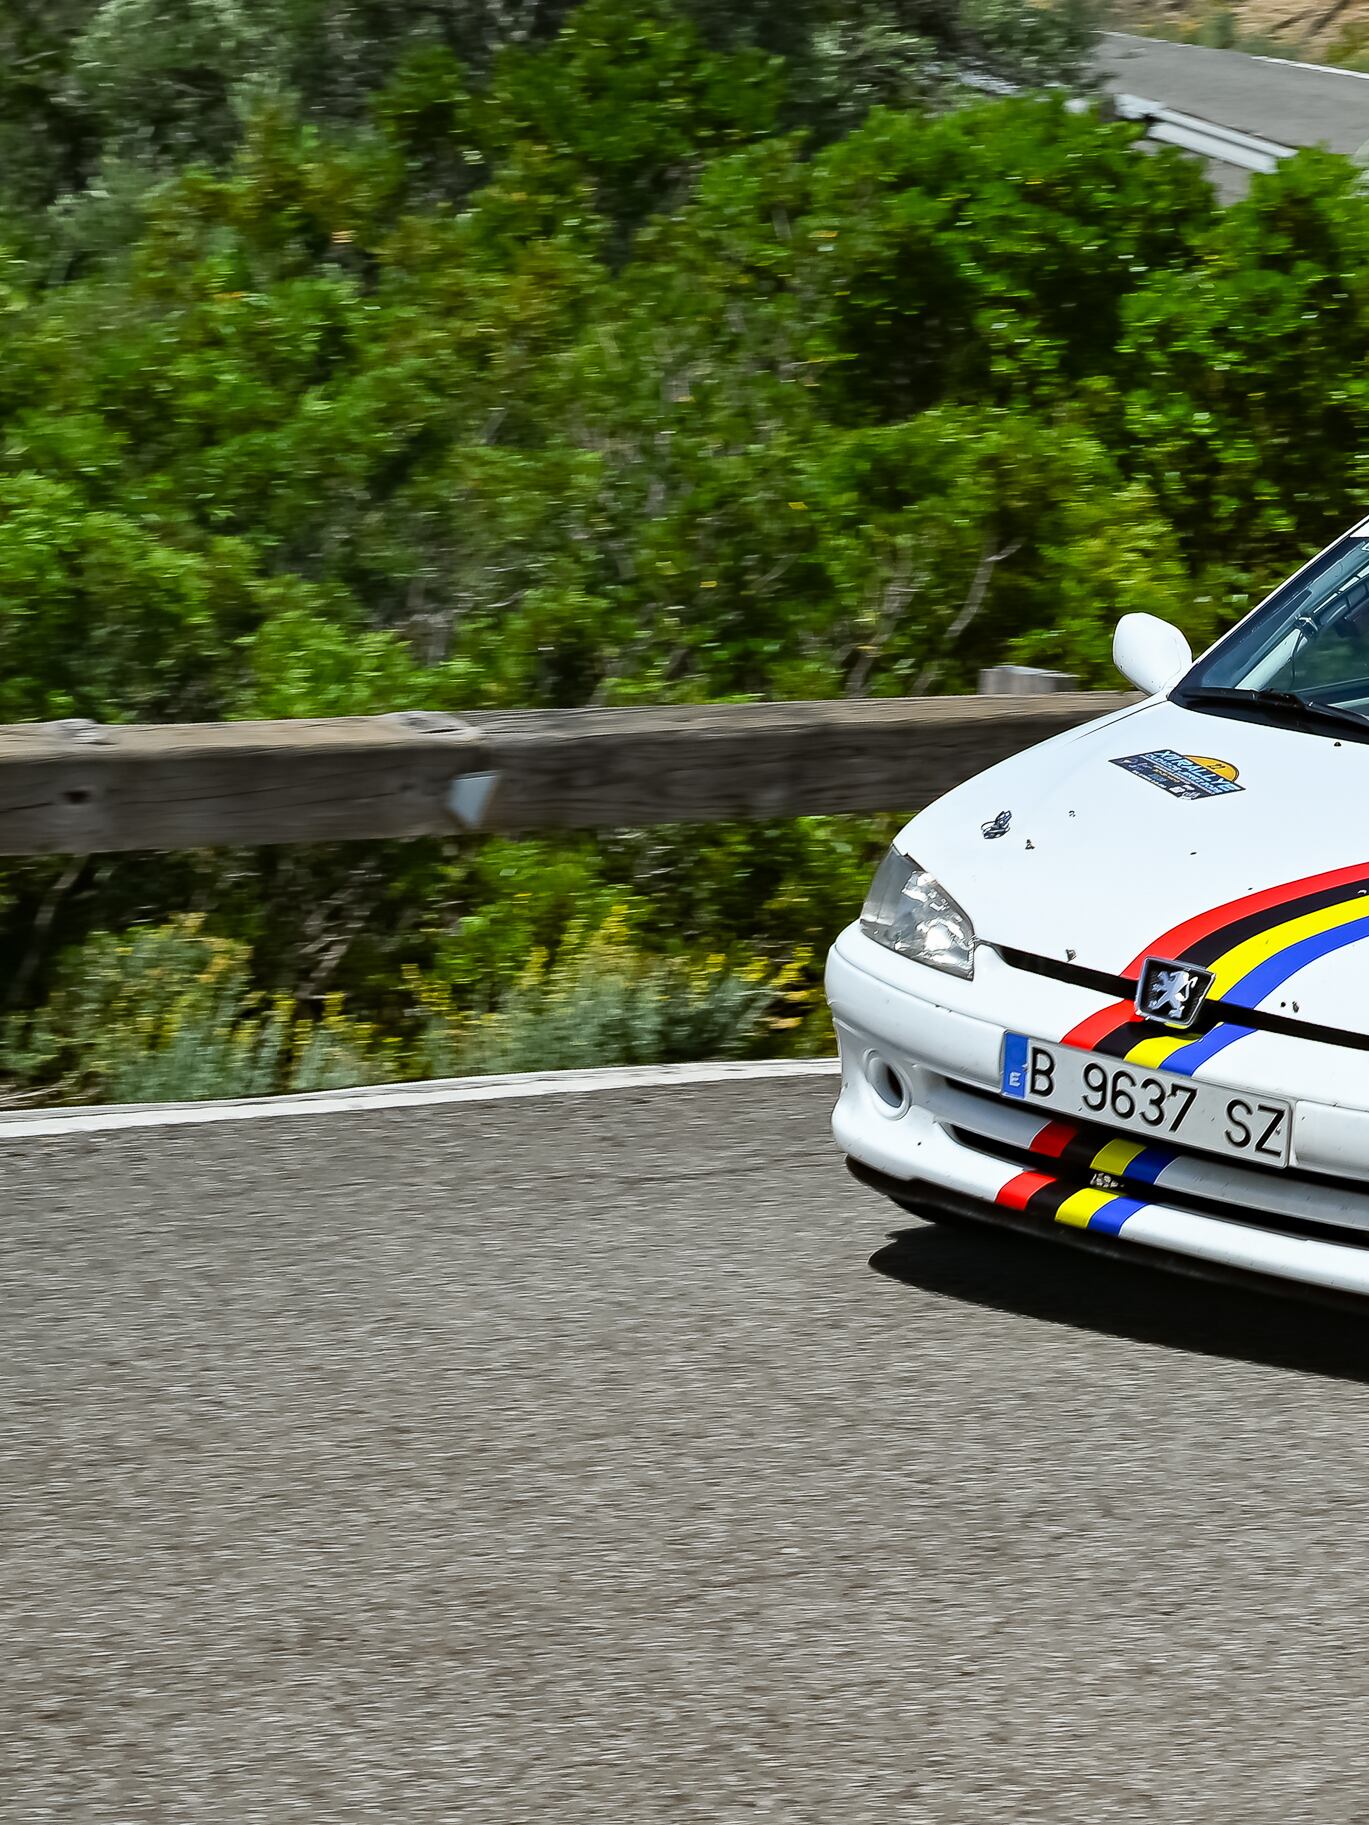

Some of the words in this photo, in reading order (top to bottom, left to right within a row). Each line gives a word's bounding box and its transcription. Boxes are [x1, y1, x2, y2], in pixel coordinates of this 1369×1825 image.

[1008, 1071, 1021, 1088] E
[1029, 1046, 1055, 1098] B
[1082, 1062, 1199, 1134] 9637
[1224, 1099, 1285, 1159] SZ
